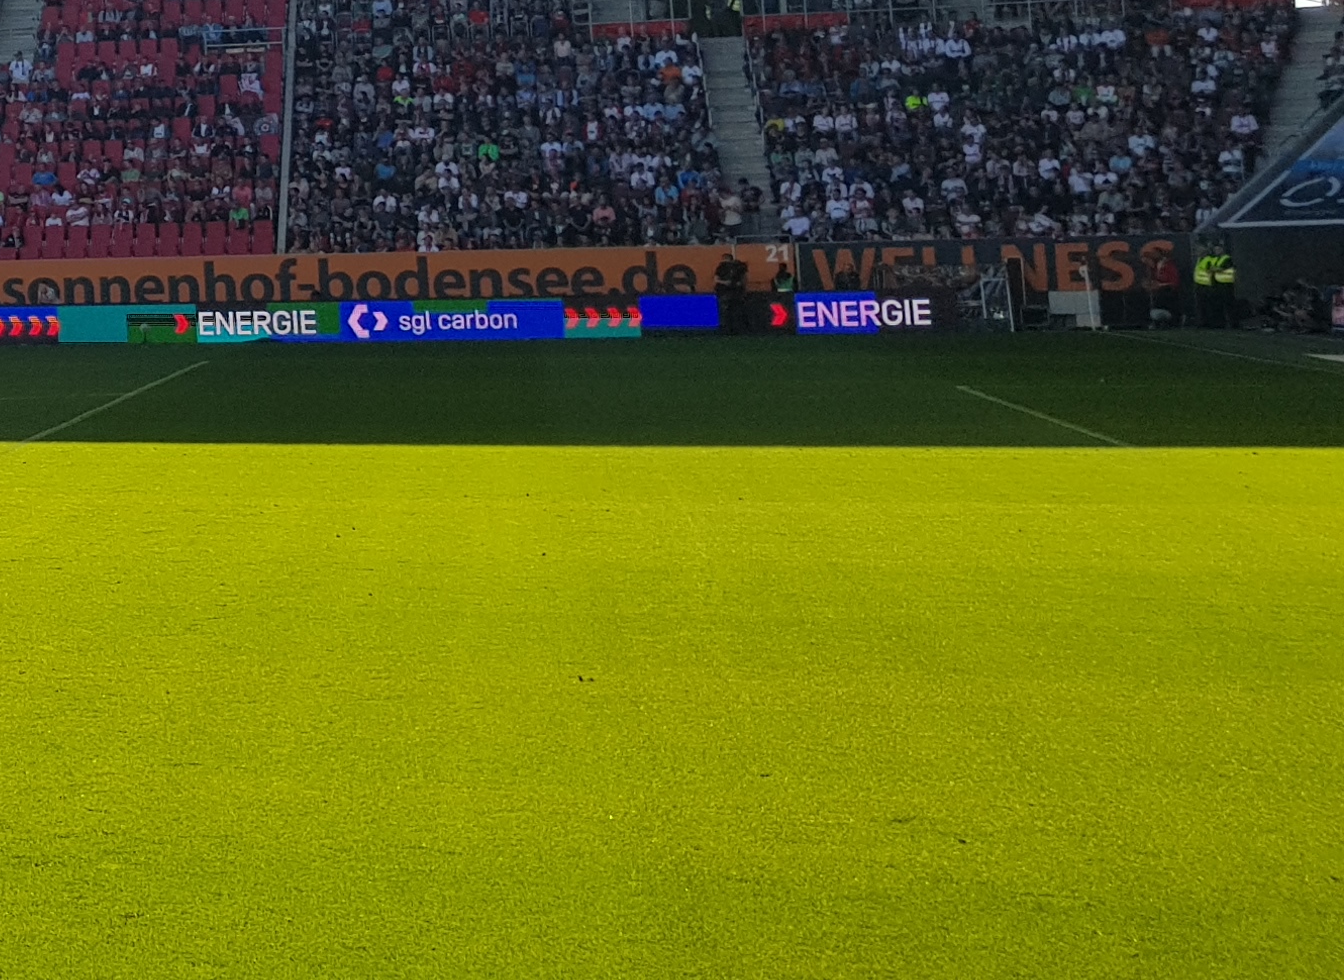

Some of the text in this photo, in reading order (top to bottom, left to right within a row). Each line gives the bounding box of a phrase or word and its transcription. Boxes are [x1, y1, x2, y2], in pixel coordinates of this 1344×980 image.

[765, 245, 790, 262] 21
[199, 310, 317, 336] ENERGIE
[398, 310, 518, 336] sgl carbon
[797, 299, 931, 328] ENERGIE
